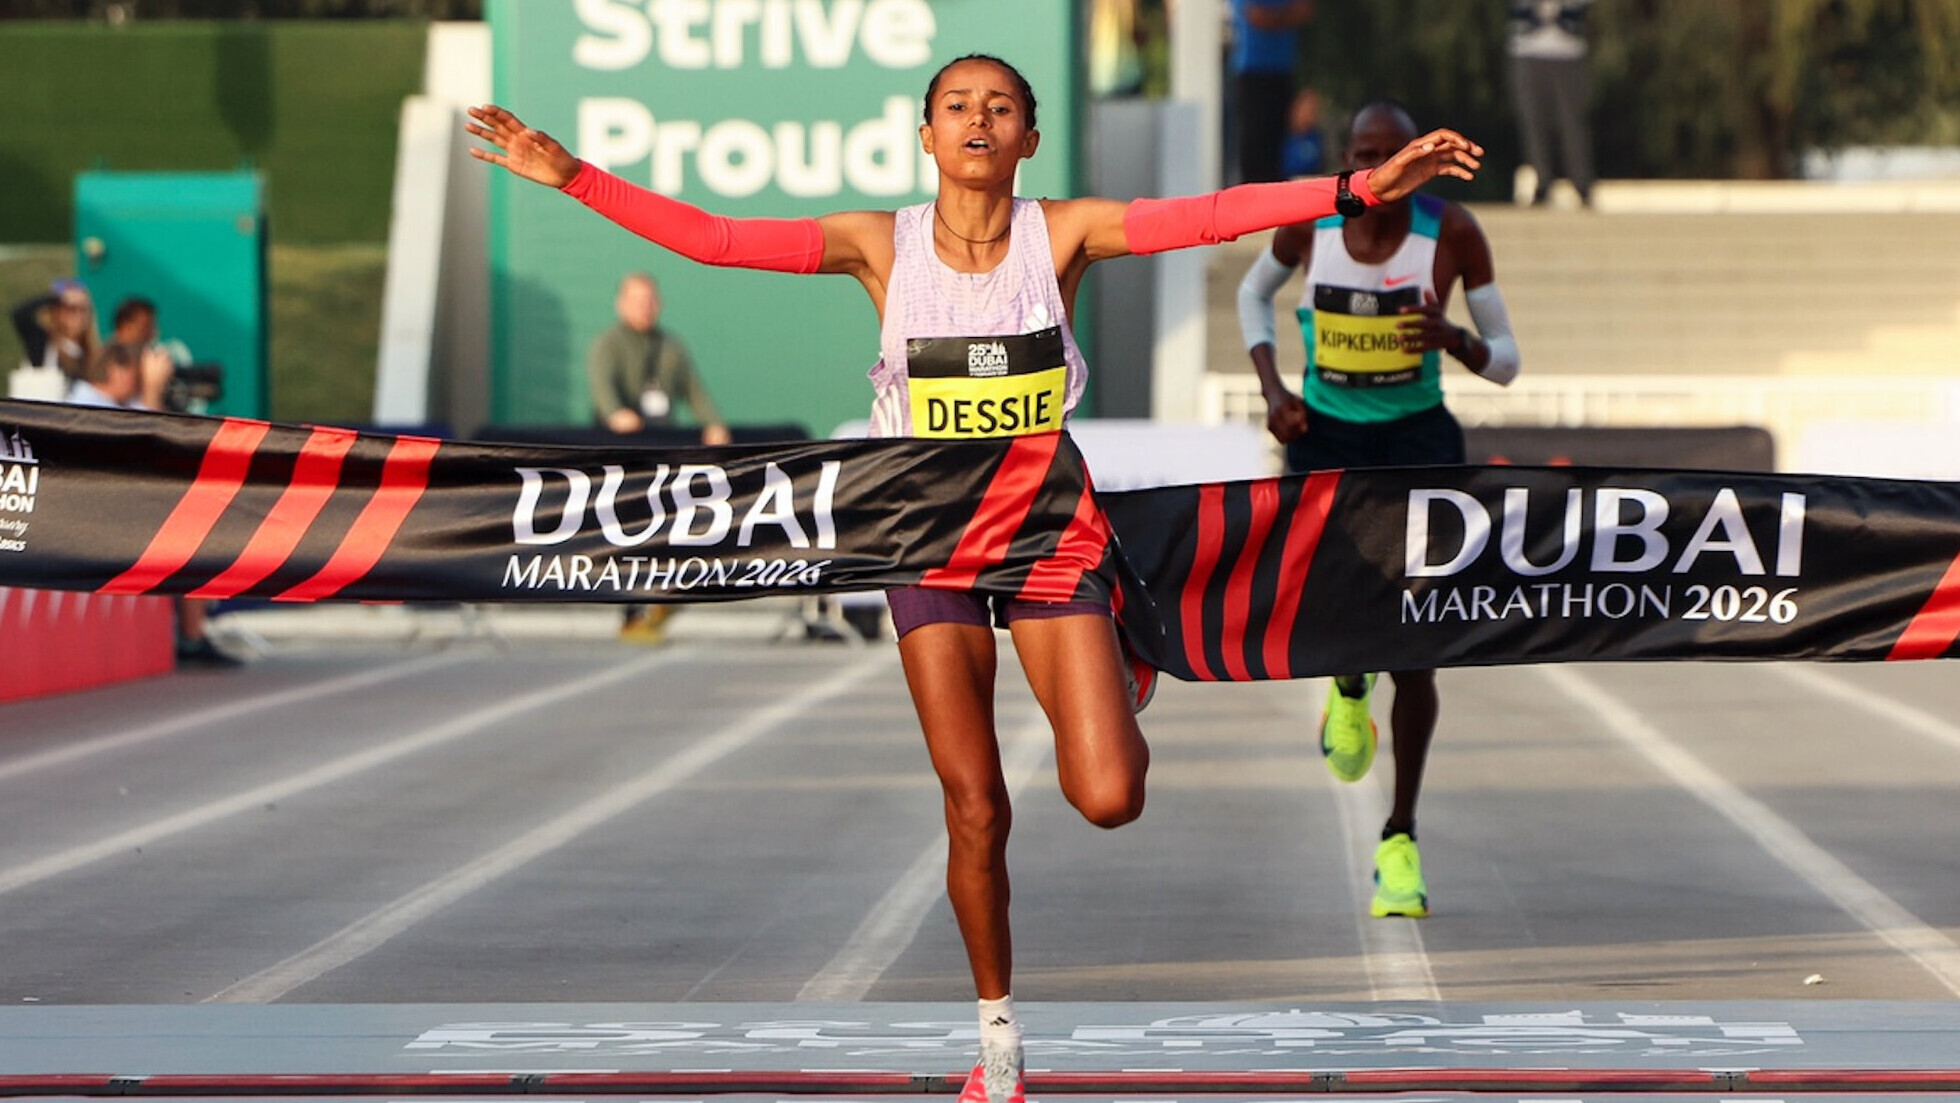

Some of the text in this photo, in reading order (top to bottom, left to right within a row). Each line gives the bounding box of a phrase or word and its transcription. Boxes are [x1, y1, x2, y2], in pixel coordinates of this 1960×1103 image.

[572, 0, 936, 69] Strive
[578, 97, 939, 197] Proud
[968, 355, 1008, 366] DUBAI
[1321, 328, 1401, 352] KIPKEMB
[928, 390, 1052, 433] DESSIE
[0, 463, 39, 495] AI
[512, 461, 840, 549] DUBAI
[1405, 488, 1806, 577] DUBAI
[501, 554, 832, 591] MARATHON 2026
[1401, 583, 1799, 624] MARATHON 2026
